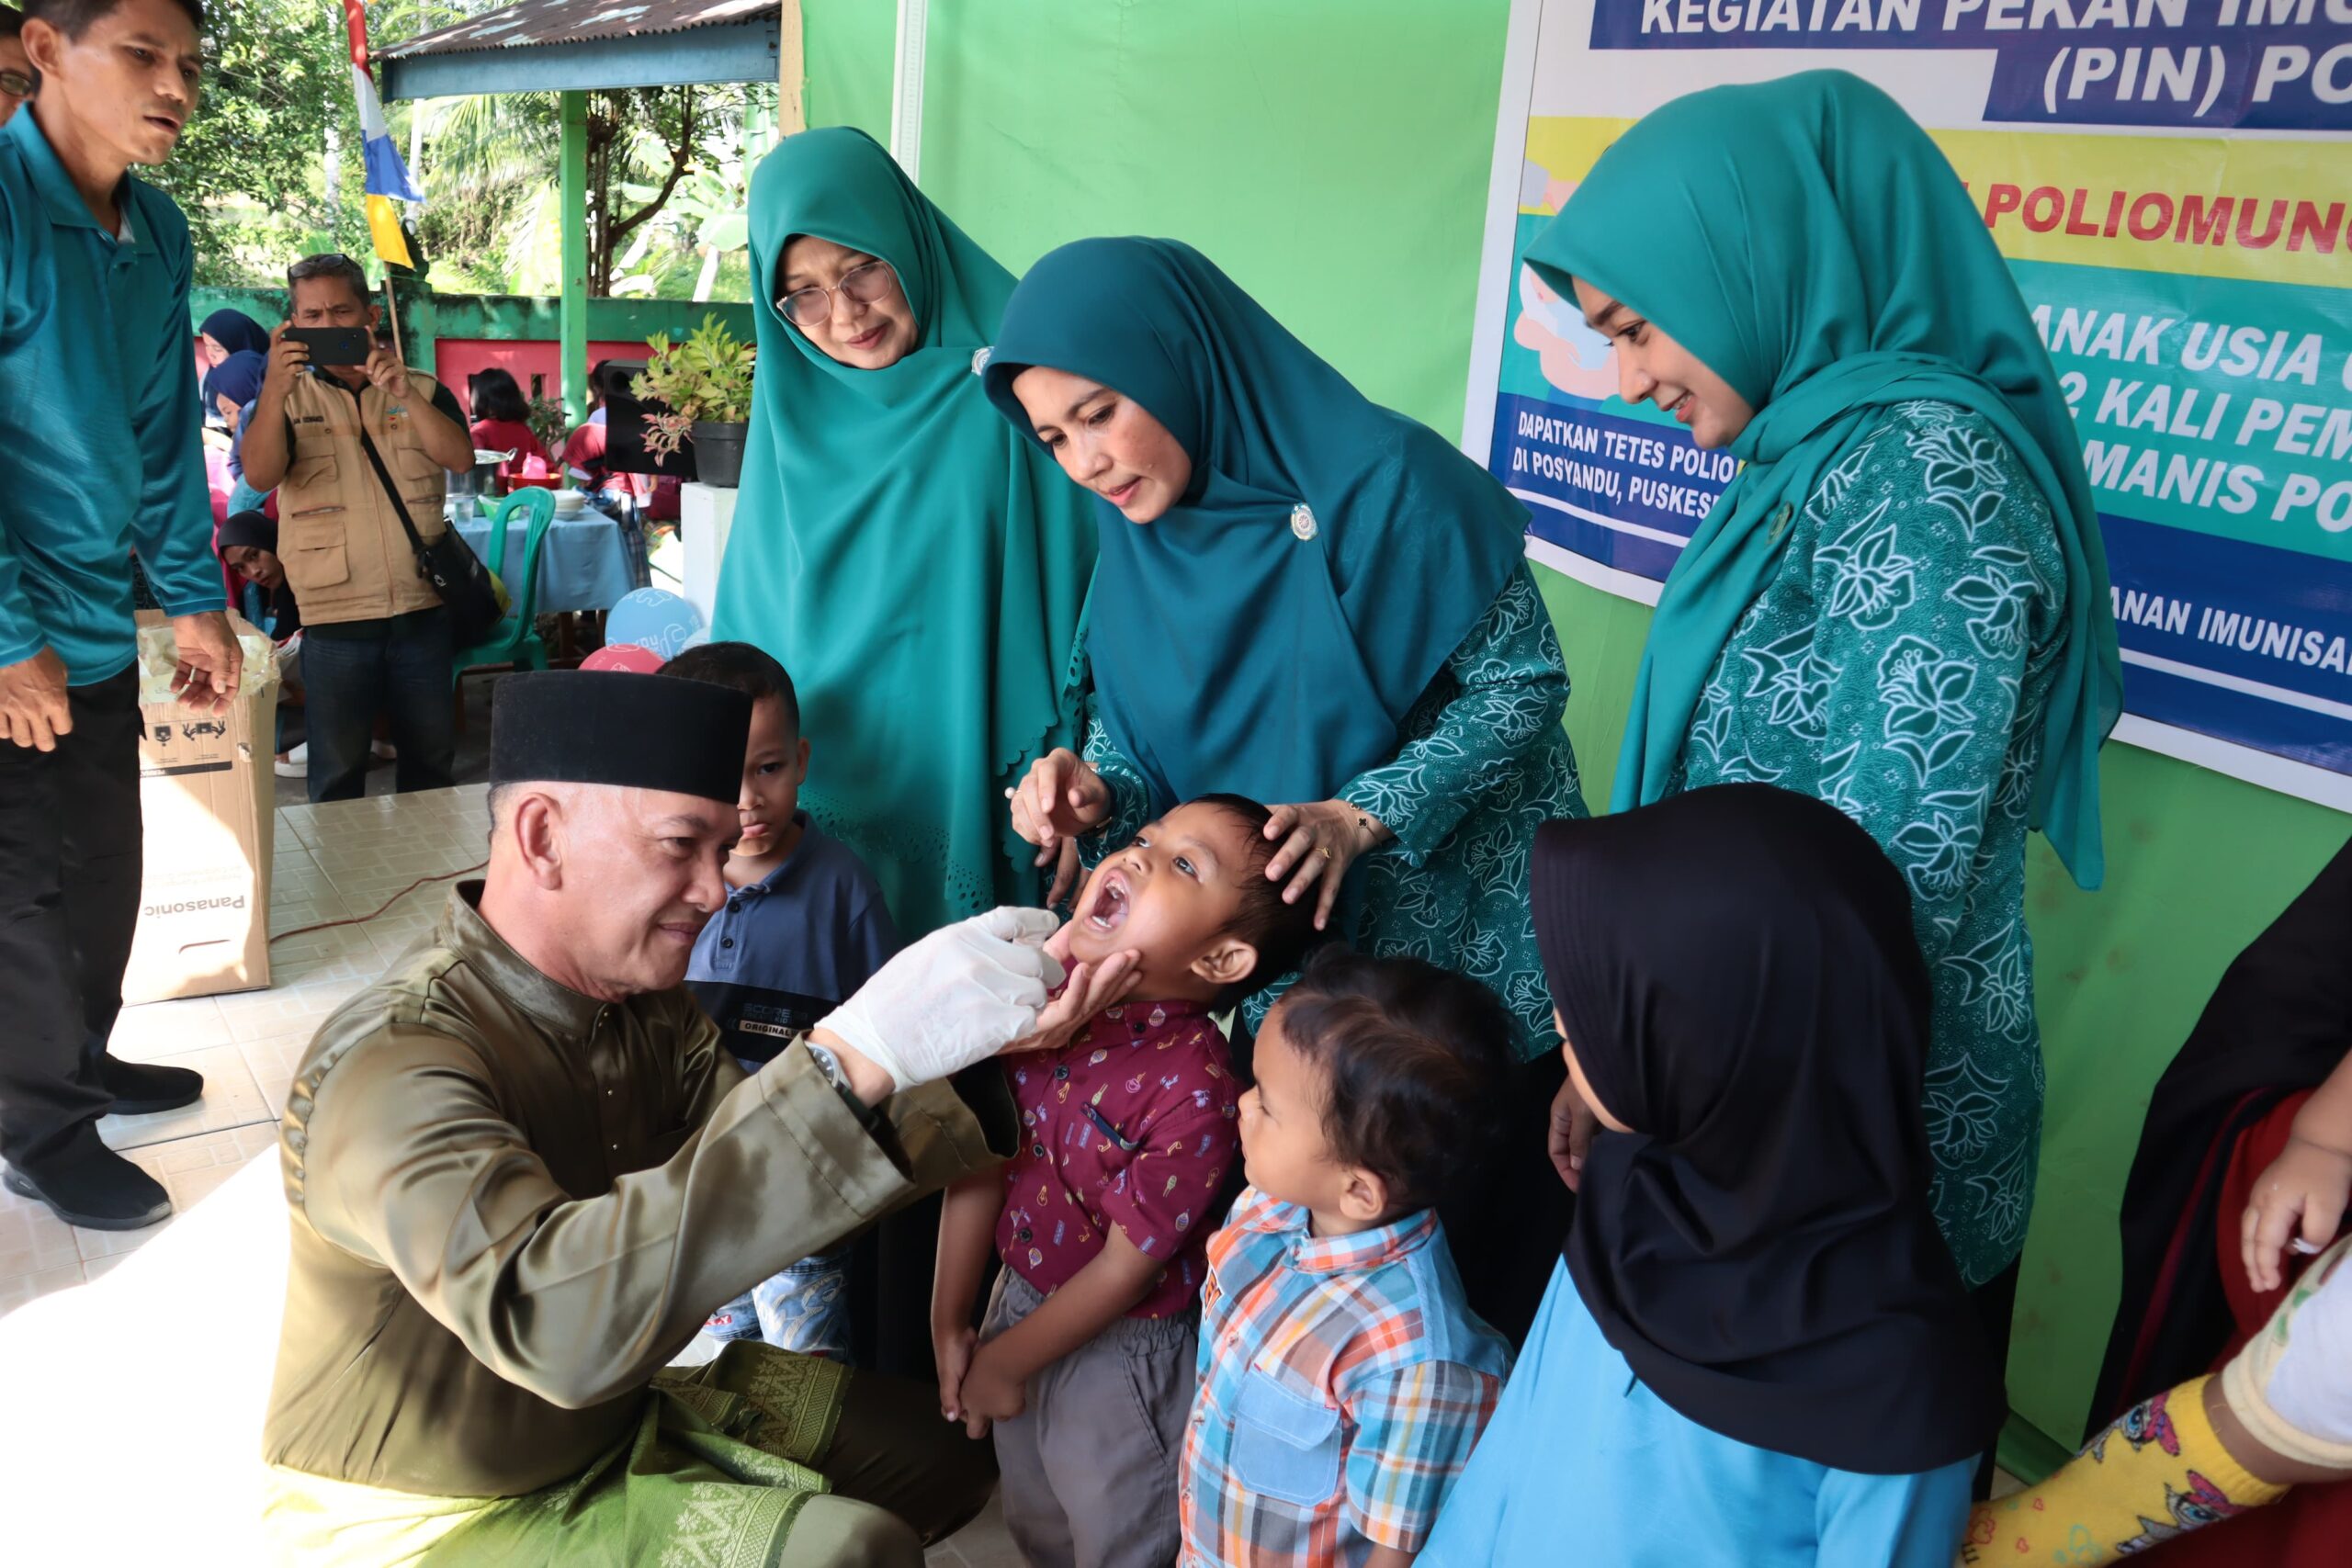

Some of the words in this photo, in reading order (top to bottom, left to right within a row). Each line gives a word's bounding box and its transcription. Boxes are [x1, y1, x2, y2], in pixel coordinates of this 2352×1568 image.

[1641, 0, 1921, 34] KEGIATAN
[1941, 0, 2189, 31] PEKAN
[2043, 45, 2226, 118] (PIN)
[1983, 183, 2352, 254] POLIOMUN
[2180, 321, 2323, 386] USIA
[2094, 377, 2233, 441] KALI
[1518, 411, 1599, 455] DAPATKAN
[1603, 430, 1666, 469] TETES
[1669, 445, 1735, 484] POLIO
[2082, 439, 2265, 514] MANIS
[1512, 446, 1529, 473] DI
[1532, 450, 1623, 505] POSYANDU,
[1628, 476, 1720, 520] PUSKES
[2197, 606, 2352, 676] IMUNISA
[143, 895, 246, 919] Panasonic
[745, 1022, 790, 1036] ORIGINAL
